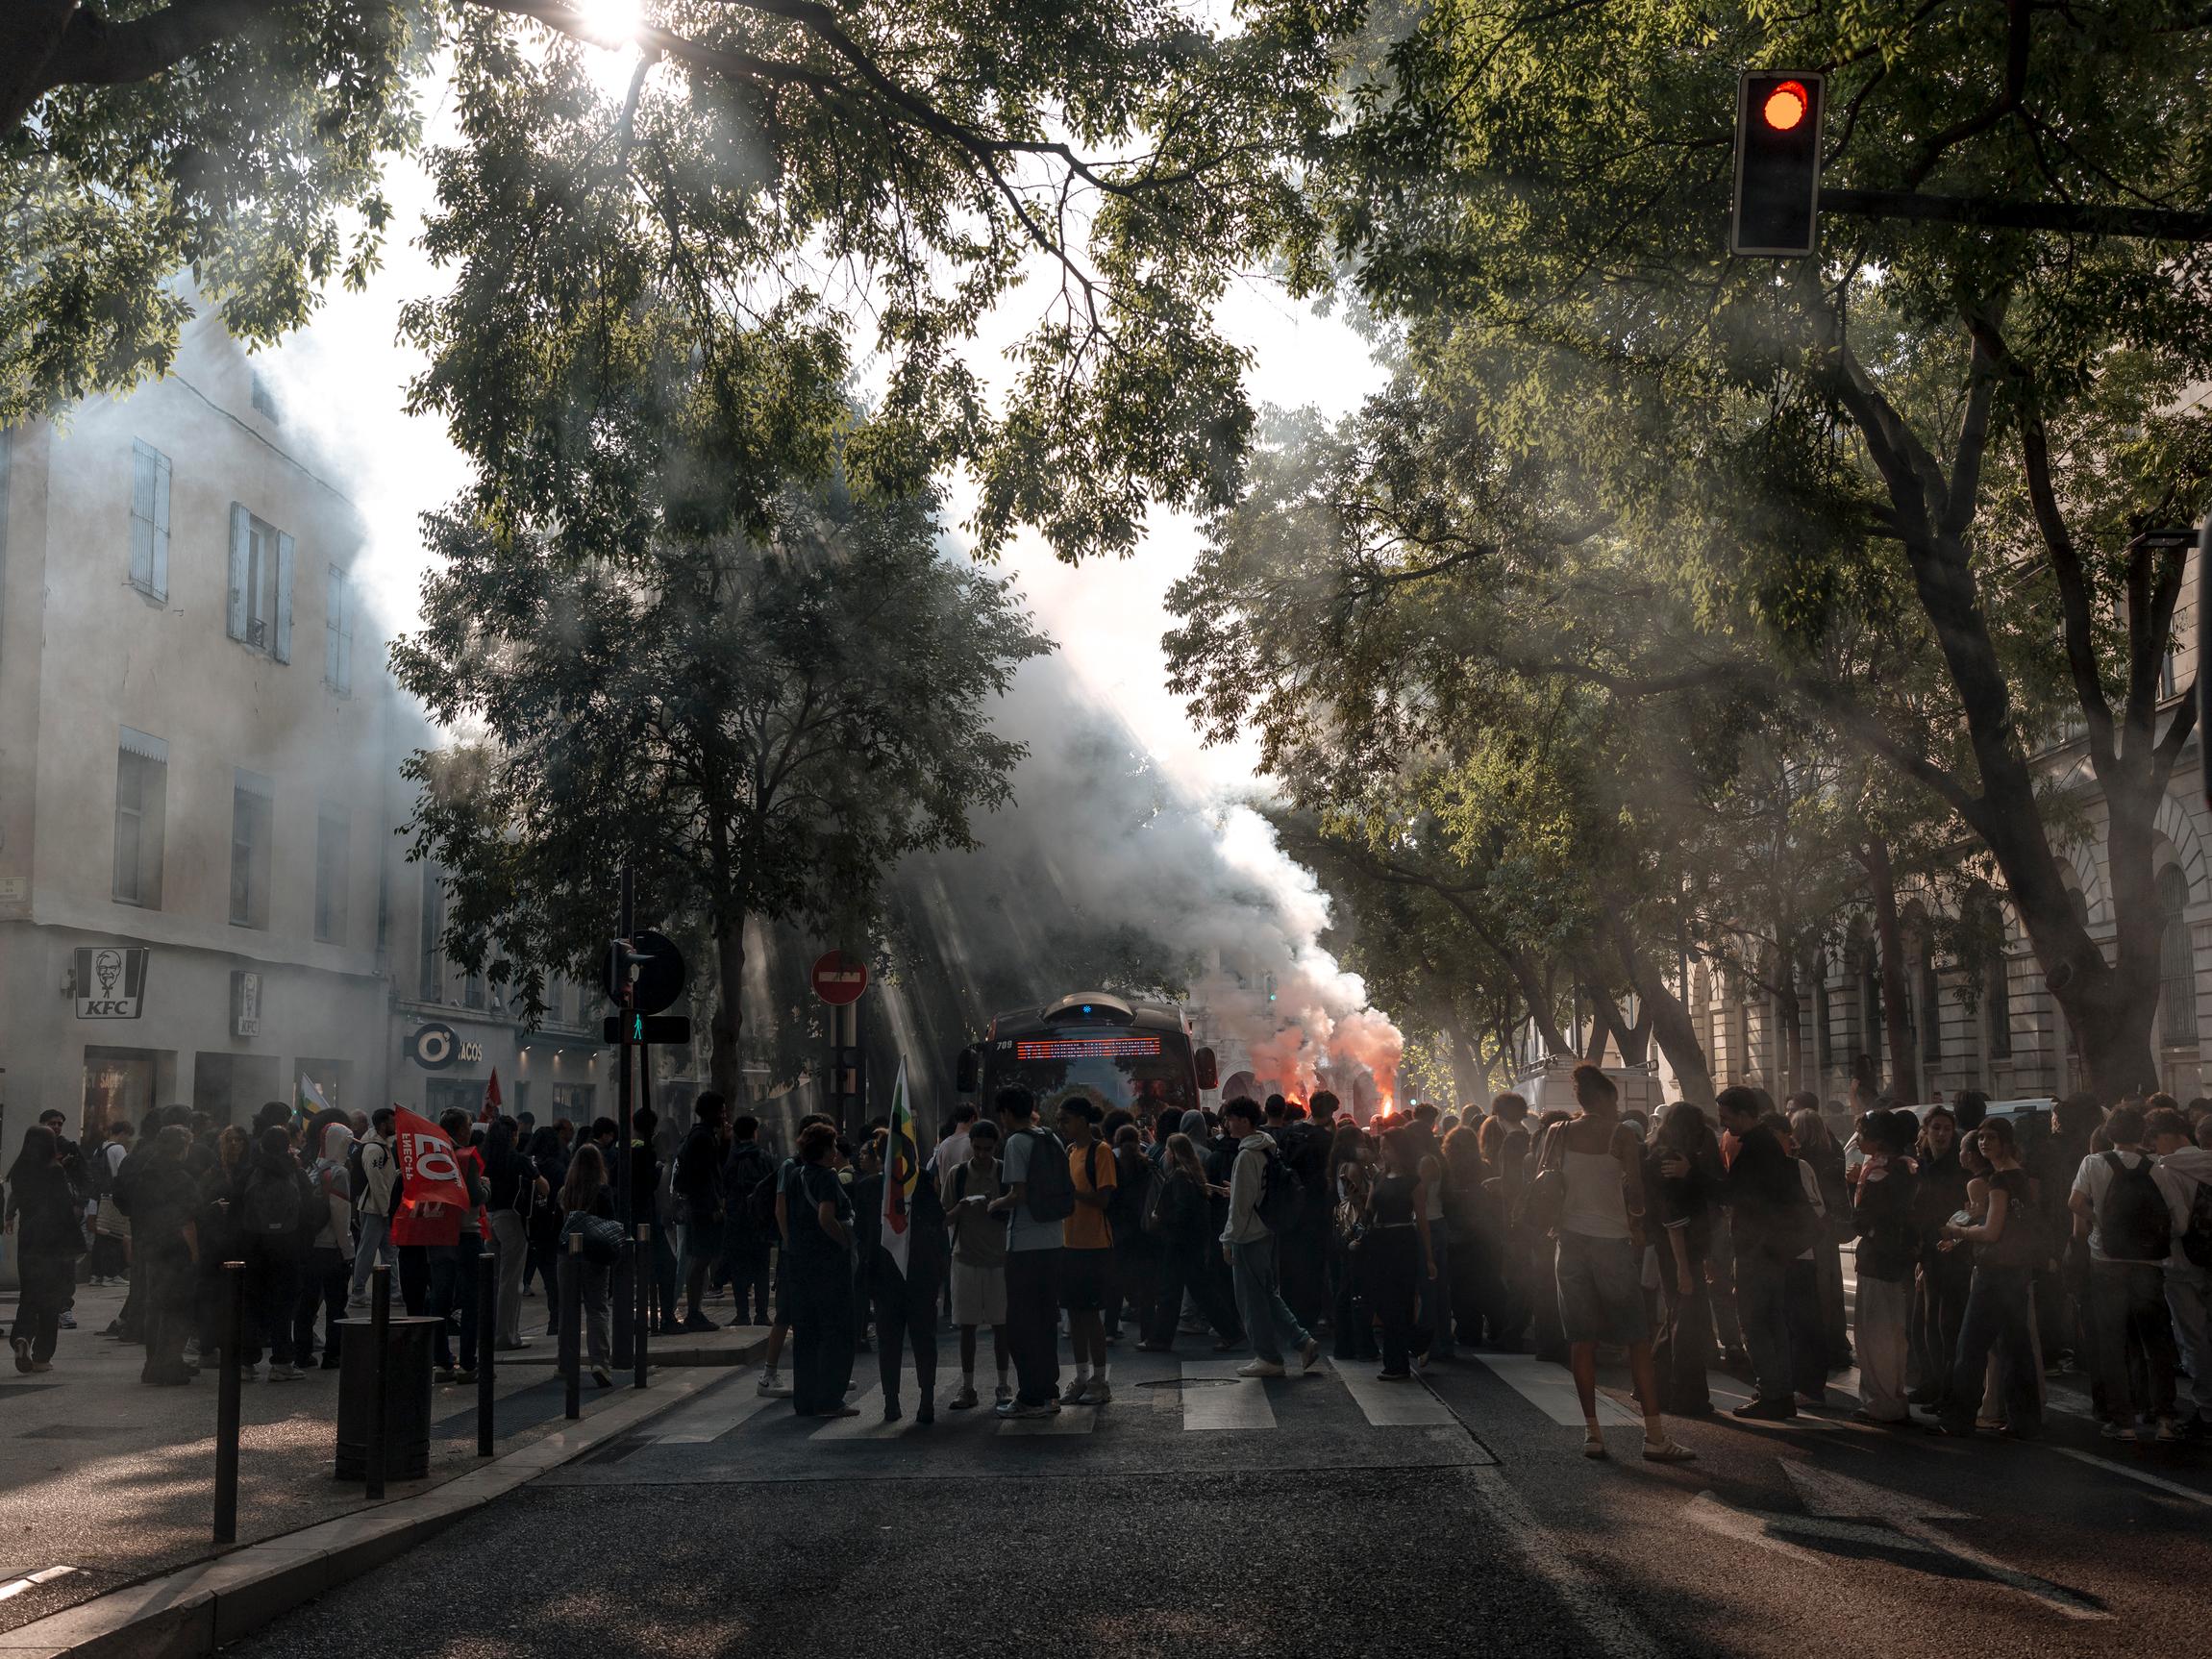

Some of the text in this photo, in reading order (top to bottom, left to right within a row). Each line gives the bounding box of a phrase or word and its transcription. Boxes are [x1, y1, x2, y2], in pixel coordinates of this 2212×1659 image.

[86, 1001, 128, 1015] KFC
[241, 1020, 257, 1033] KFC
[996, 1040, 1012, 1051] 709
